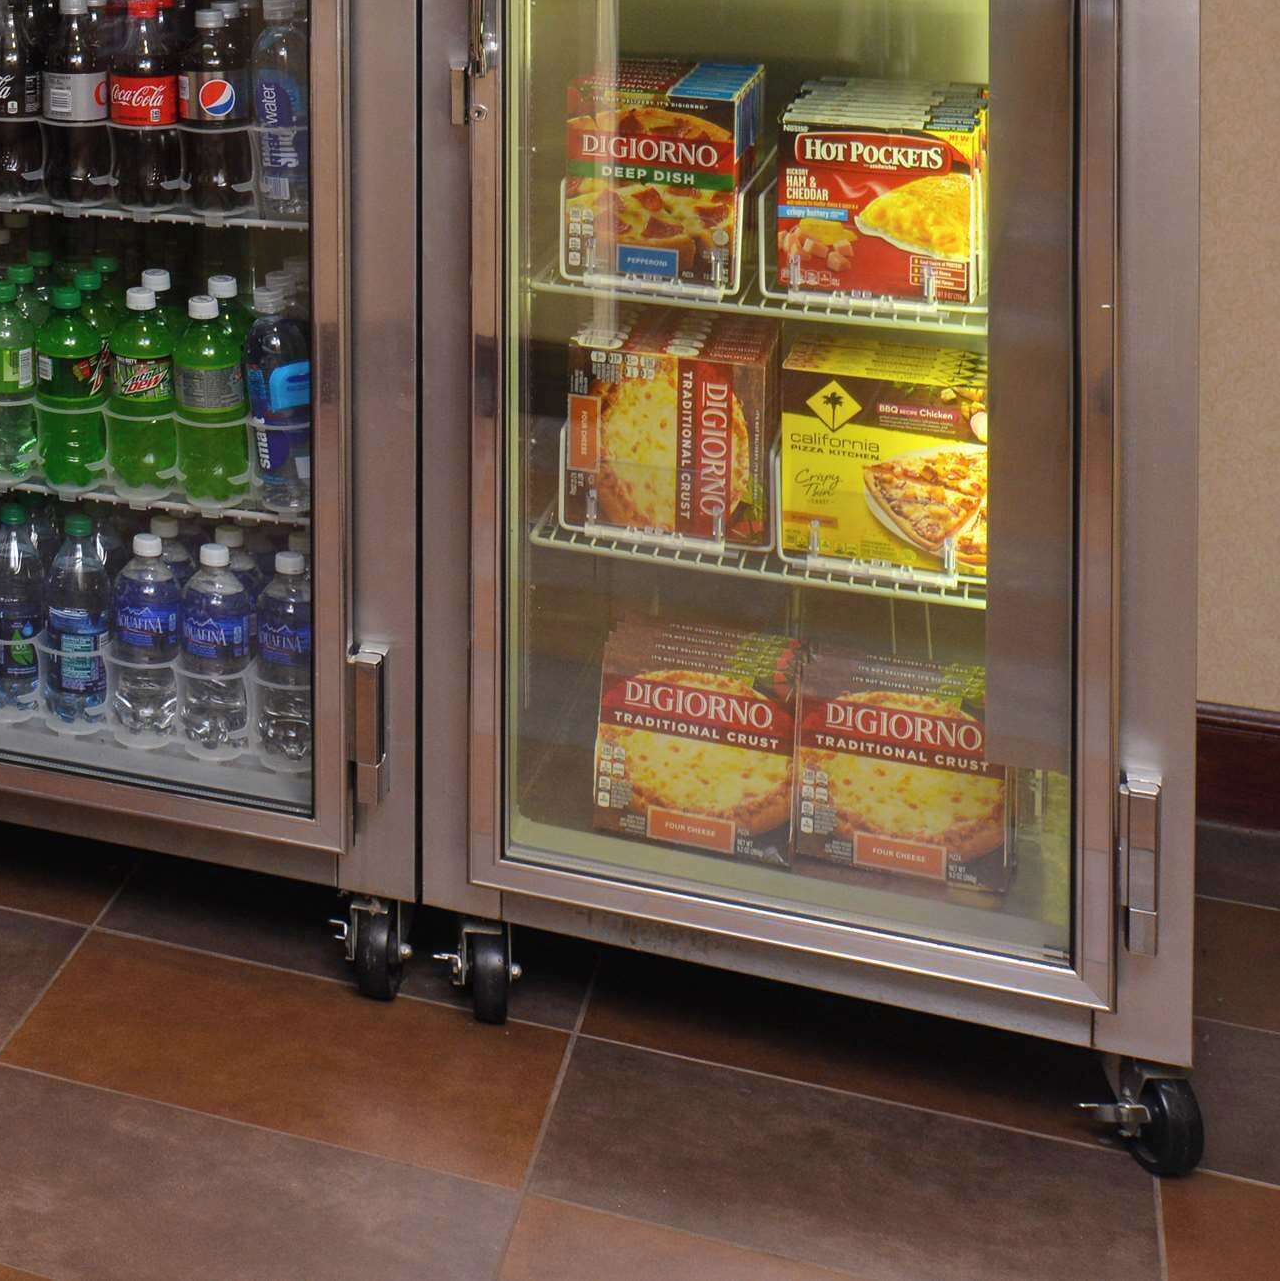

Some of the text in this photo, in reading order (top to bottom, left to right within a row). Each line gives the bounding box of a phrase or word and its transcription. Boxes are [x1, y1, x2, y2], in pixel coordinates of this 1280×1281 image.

[111, 82, 166, 108] Coca-Cola
[582, 133, 719, 169] DIGIORNO
[804, 137, 944, 170] HOT POCKETS
[600, 165, 696, 186] DEEP DISH
[786, 175, 817, 188] HAM &
[786, 187, 829, 201] CHEDDAR
[626, 256, 668, 268] PEPPERONI
[879, 404, 954, 420] BBQ Chicken
[679, 371, 693, 520] TRADITIONAL CRUST
[699, 382, 729, 516] DIGIORNO
[791, 431, 881, 453] california
[791, 443, 879, 461] PIZZA KITCHEN
[794, 467, 843, 489] Crispy
[624, 680, 772, 729] DIGIORNO
[614, 710, 780, 750] TRADITIONAL CRUST
[825, 701, 981, 752] DIGIORNO
[815, 734, 990, 773] TRADITIONAL CRUST
[664, 821, 717, 839] FOUR CHEESE
[872, 846, 927, 864] FOUR CHEESE
